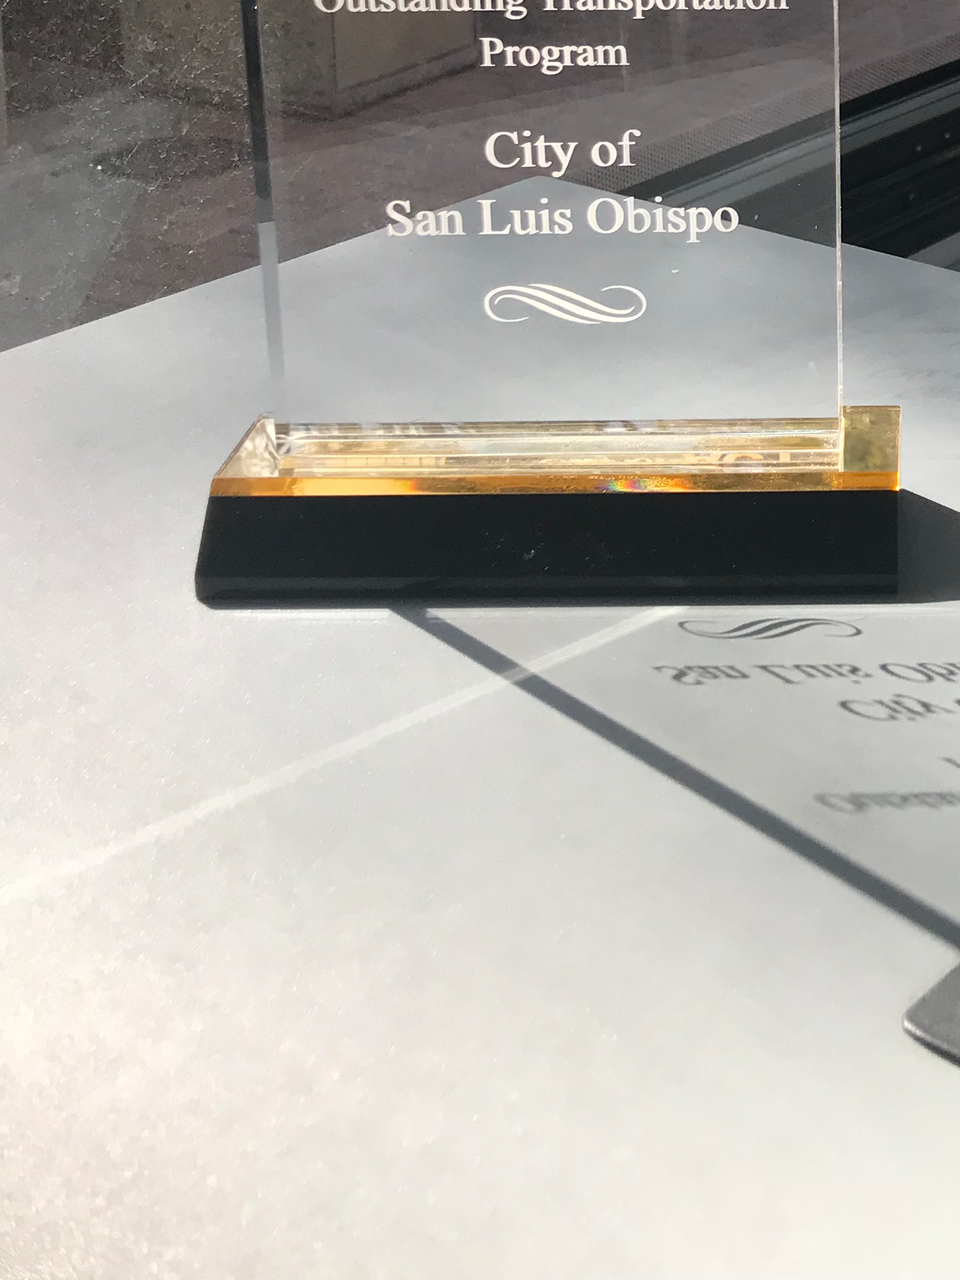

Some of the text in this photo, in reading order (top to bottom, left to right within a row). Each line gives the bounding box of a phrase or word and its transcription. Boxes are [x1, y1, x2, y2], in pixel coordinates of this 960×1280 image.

[479, 37, 630, 76] Program
[485, 128, 642, 178] City of
[386, 196, 740, 242] San Luis Obispo
